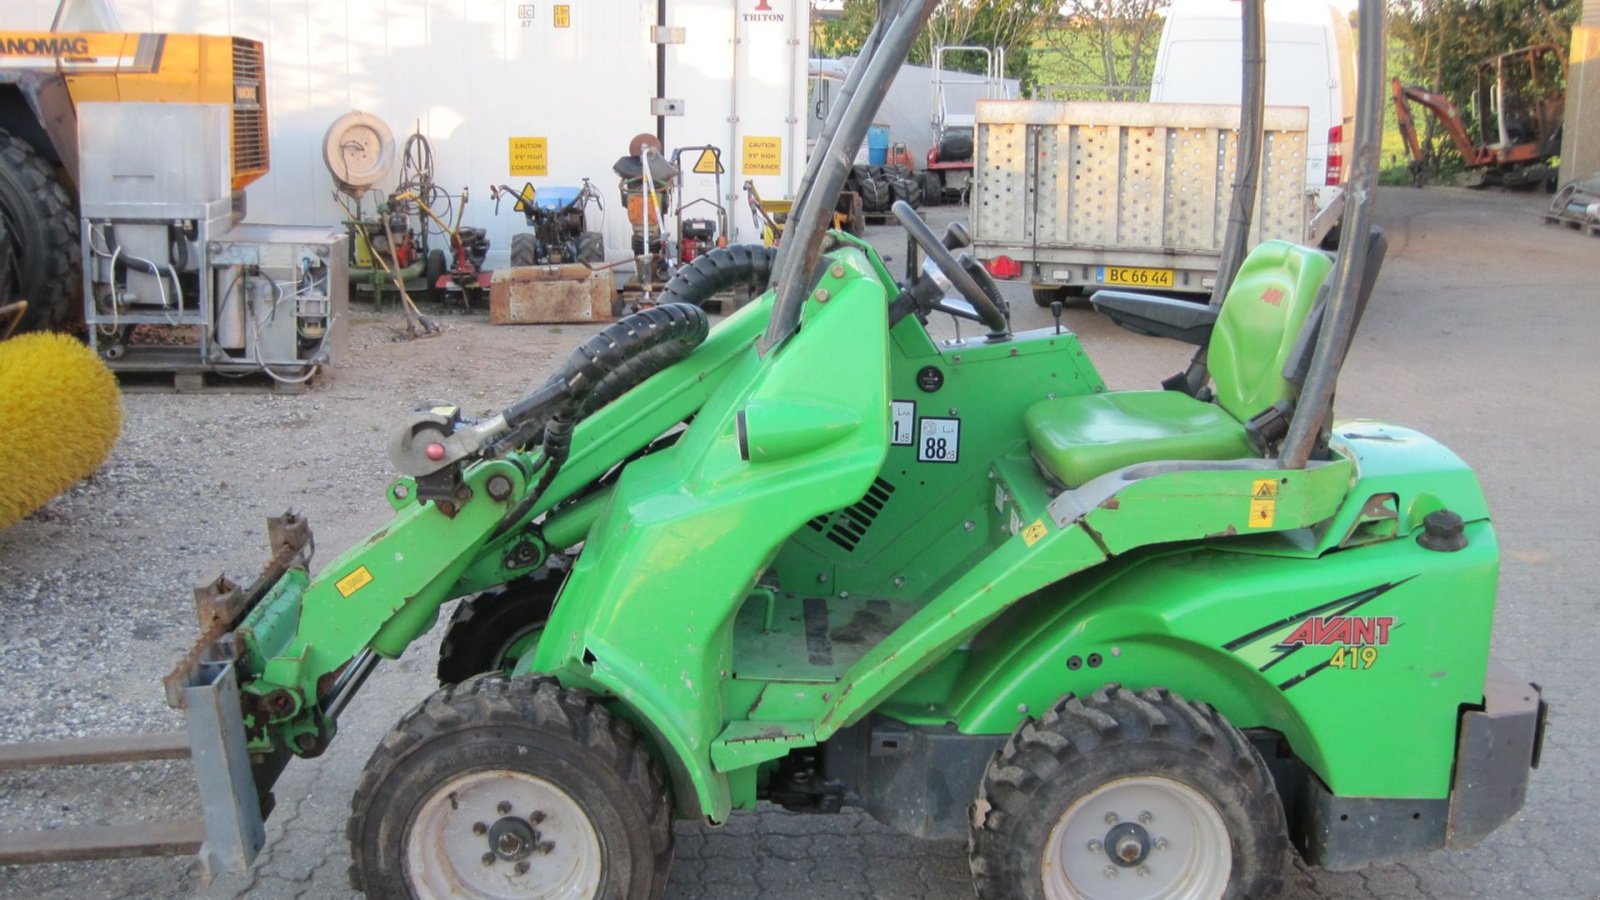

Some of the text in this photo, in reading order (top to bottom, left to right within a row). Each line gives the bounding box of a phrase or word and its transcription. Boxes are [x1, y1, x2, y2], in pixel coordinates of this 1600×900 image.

[742, 13, 784, 22] TRITON
[1110, 269, 1168, 284] BC 66 44
[925, 437, 947, 459] 88
[1280, 616, 1394, 645] AVANT
[1329, 647, 1378, 669] 419
